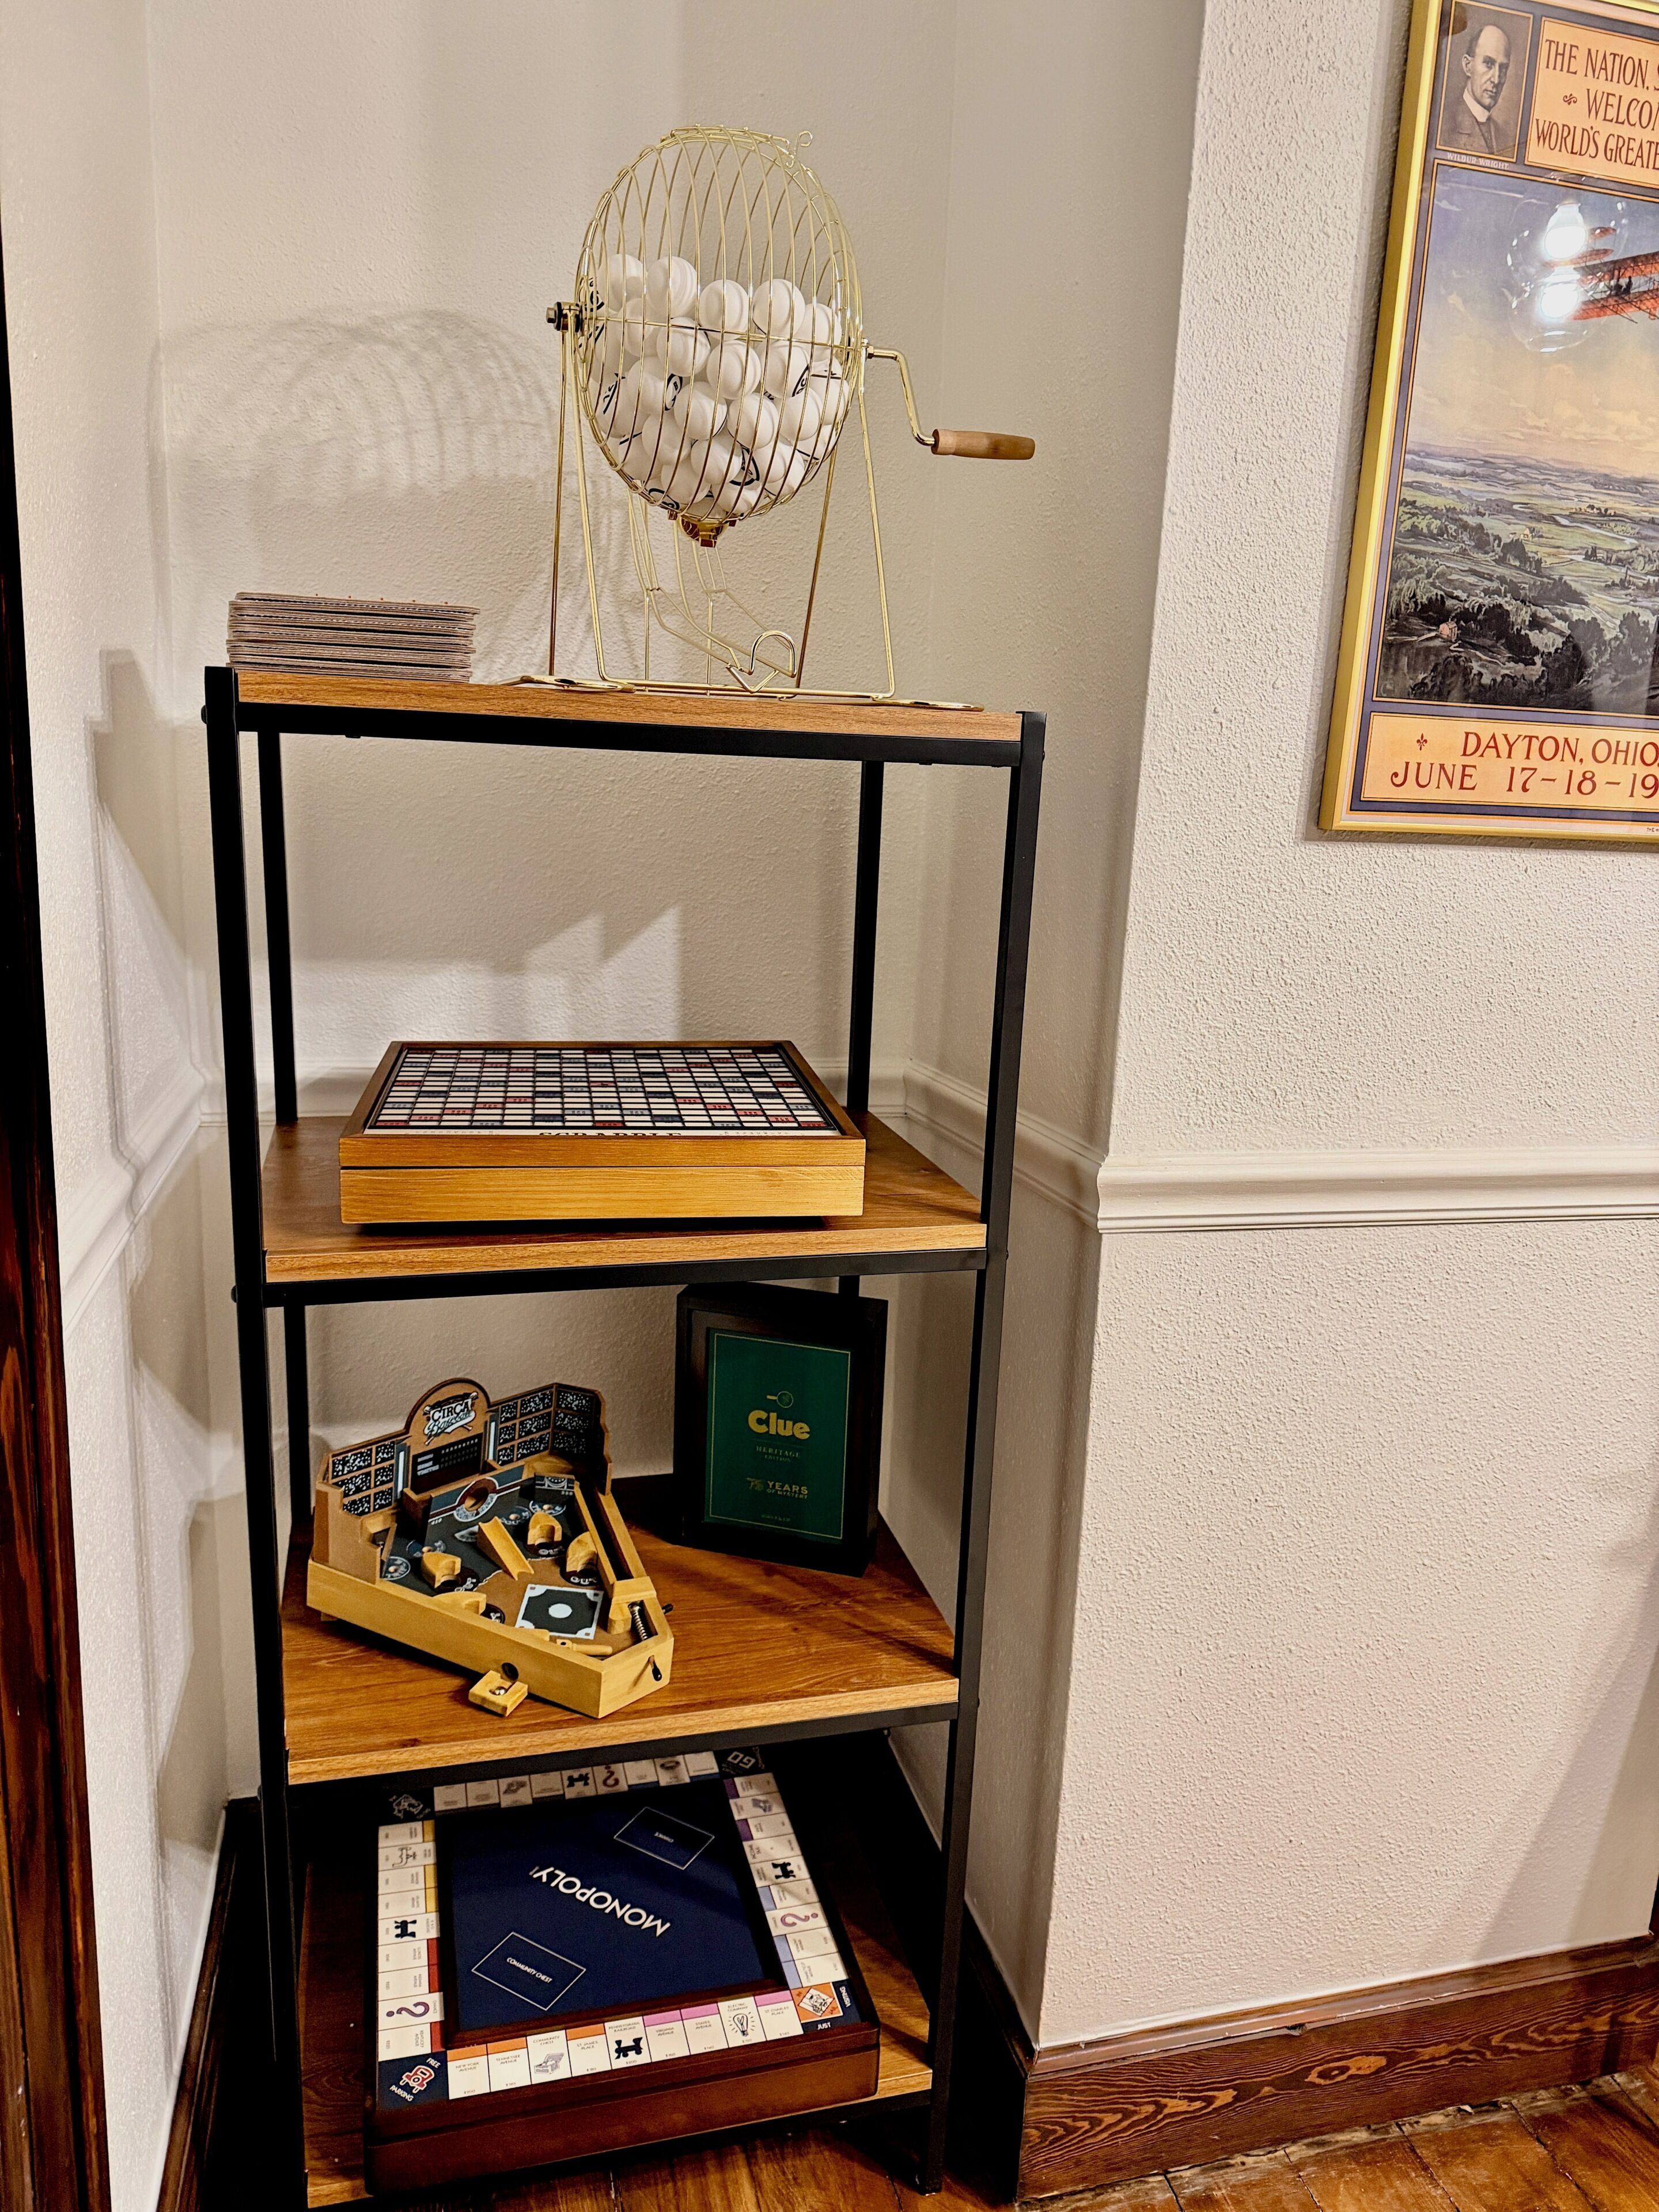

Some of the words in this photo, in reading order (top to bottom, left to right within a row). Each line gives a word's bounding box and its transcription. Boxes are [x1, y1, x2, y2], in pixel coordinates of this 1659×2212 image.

[1546, 39, 1579, 74] THE
[1586, 89, 1659, 131] WELCO
[1536, 118, 1600, 158] WORLD'S
[1461, 732, 1584, 764] DAYTON,
[1391, 762, 1478, 790] JUNE
[432, 1400, 470, 1422] CIRCA
[748, 1410, 810, 1440] Clue
[756, 1446, 800, 1458] HERITAGE
[767, 1480, 808, 1494] YEARS
[533, 1867, 671, 1937] MONOPOLY
[507, 1957, 537, 1975] COMMUNITY
[535, 1972, 552, 1983] CHEST
[839, 1986, 851, 2008] VISITING
[817, 2022, 831, 2030] JUST
[426, 2058, 441, 2069] FREE
[389, 2085, 414, 2101] PARKING
